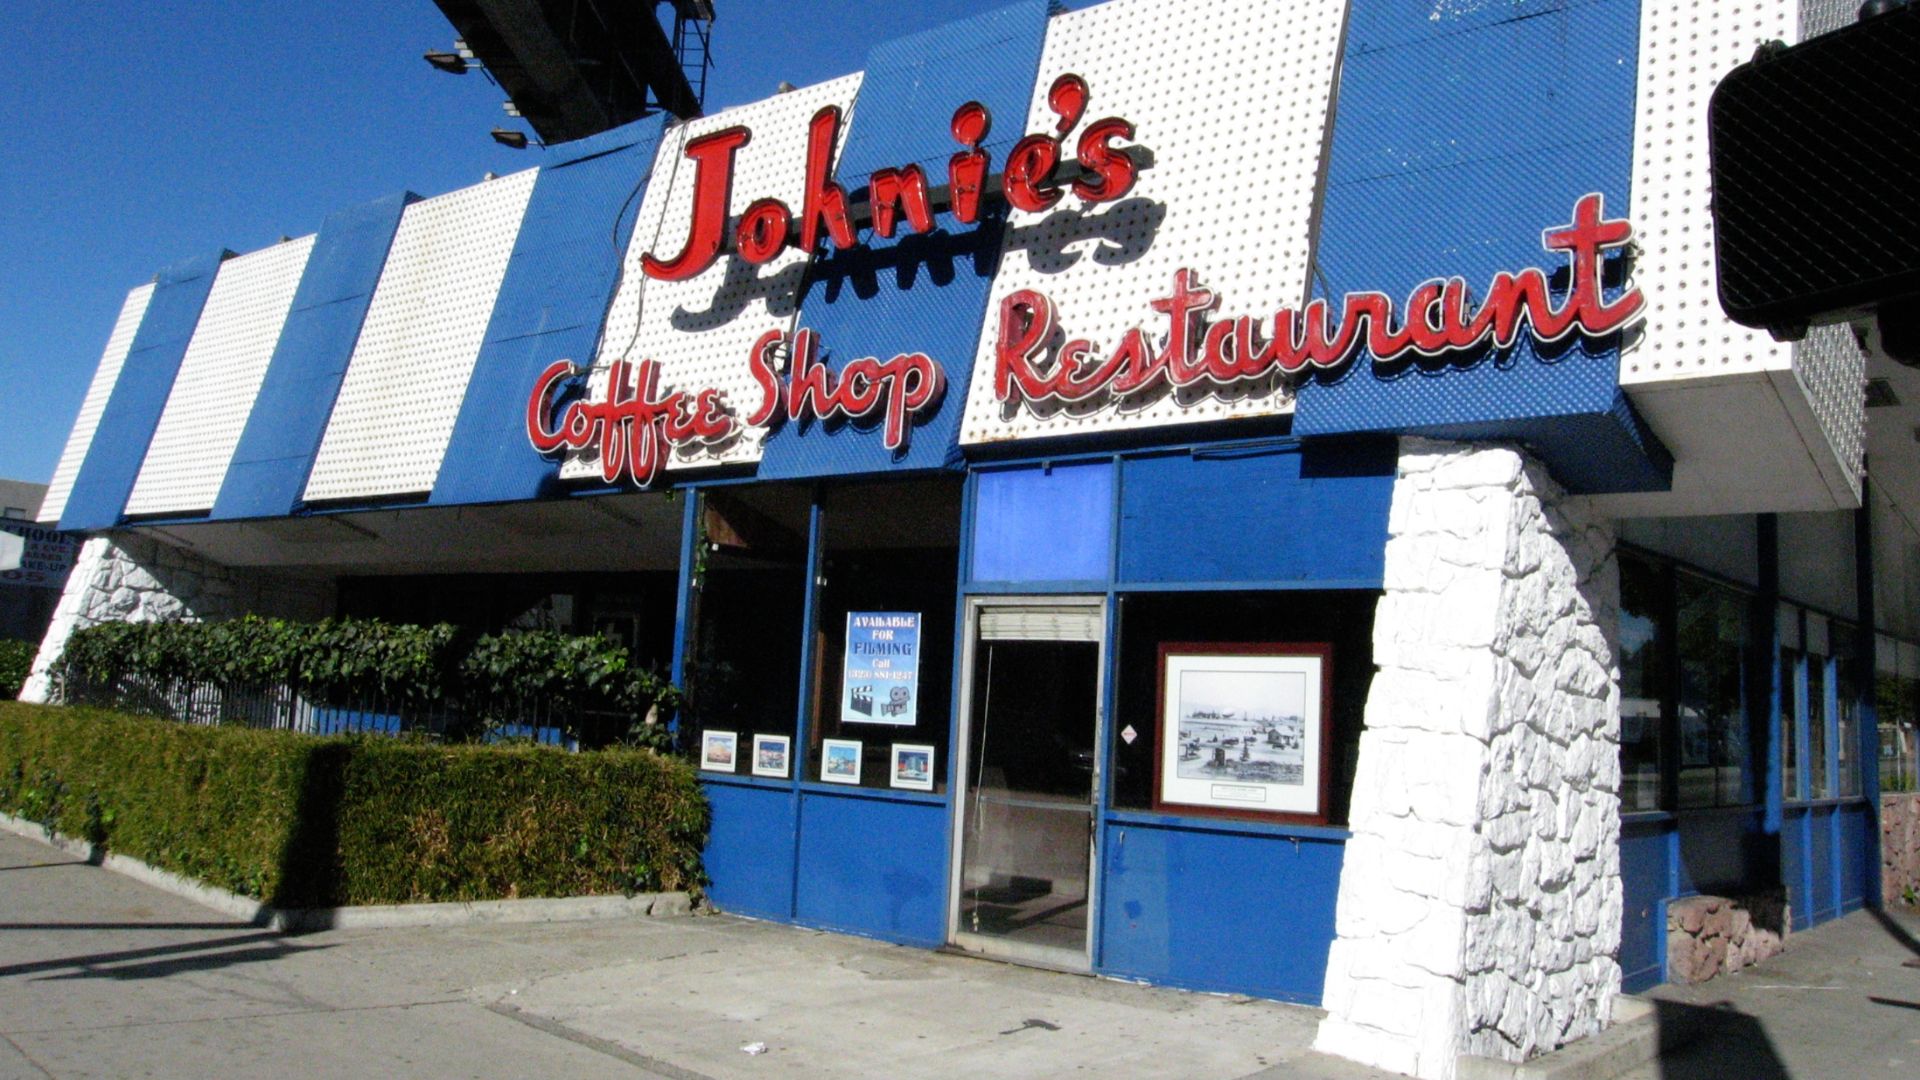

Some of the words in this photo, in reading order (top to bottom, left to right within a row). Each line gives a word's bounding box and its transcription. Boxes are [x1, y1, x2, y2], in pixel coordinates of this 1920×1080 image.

[641, 74, 1136, 281] Johnie's
[528, 358, 736, 487] Coffee
[747, 327, 945, 450] Shop
[995, 192, 1646, 405] Restaurant
[853, 616, 915, 628] AVAILABLE
[872, 630, 894, 640] FOR
[854, 642, 912, 655] FILMING
[872, 659, 890, 668] Call
